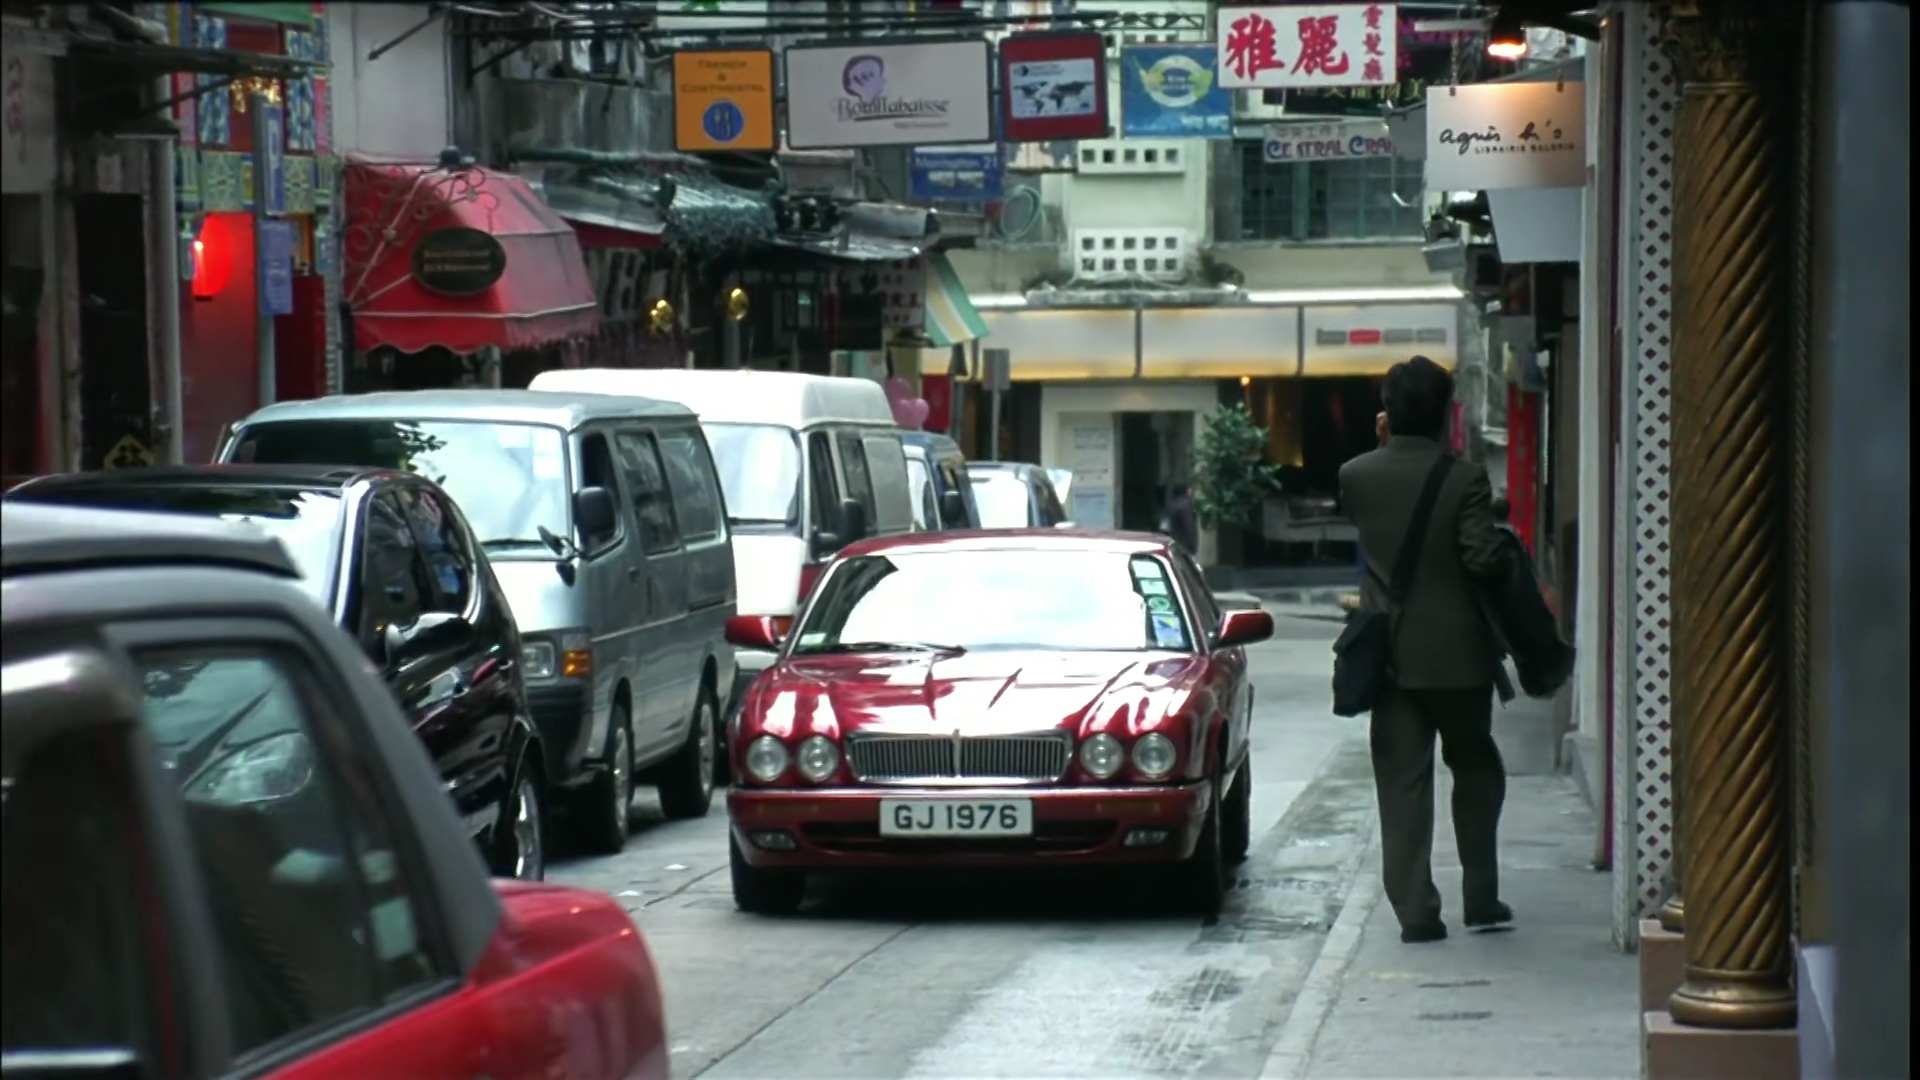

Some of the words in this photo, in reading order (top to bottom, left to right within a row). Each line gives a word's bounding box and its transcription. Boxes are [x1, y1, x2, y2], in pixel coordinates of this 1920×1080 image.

[1225, 13, 1350, 82] 雅麗
[894, 804, 934, 830] GJ
[946, 804, 1018, 830] 1976
